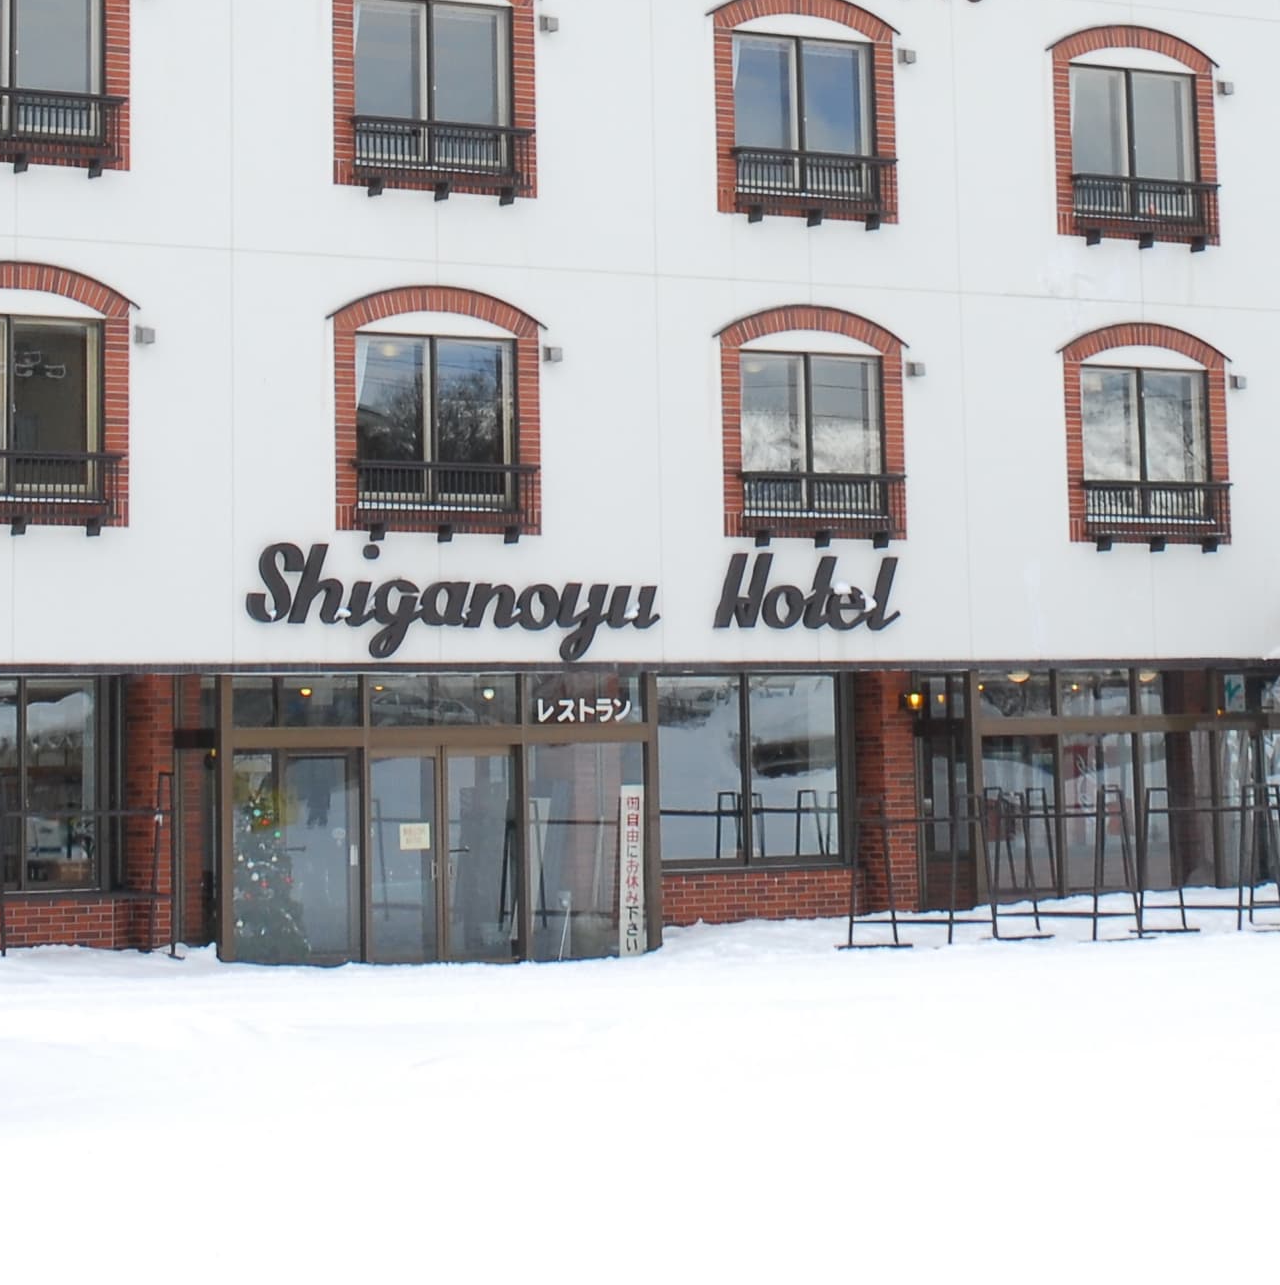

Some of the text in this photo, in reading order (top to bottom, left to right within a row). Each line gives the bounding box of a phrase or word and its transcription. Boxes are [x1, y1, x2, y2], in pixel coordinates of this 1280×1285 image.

[246, 543, 901, 661] Shiganoyu Hotel
[537, 698, 631, 723] レストラン
